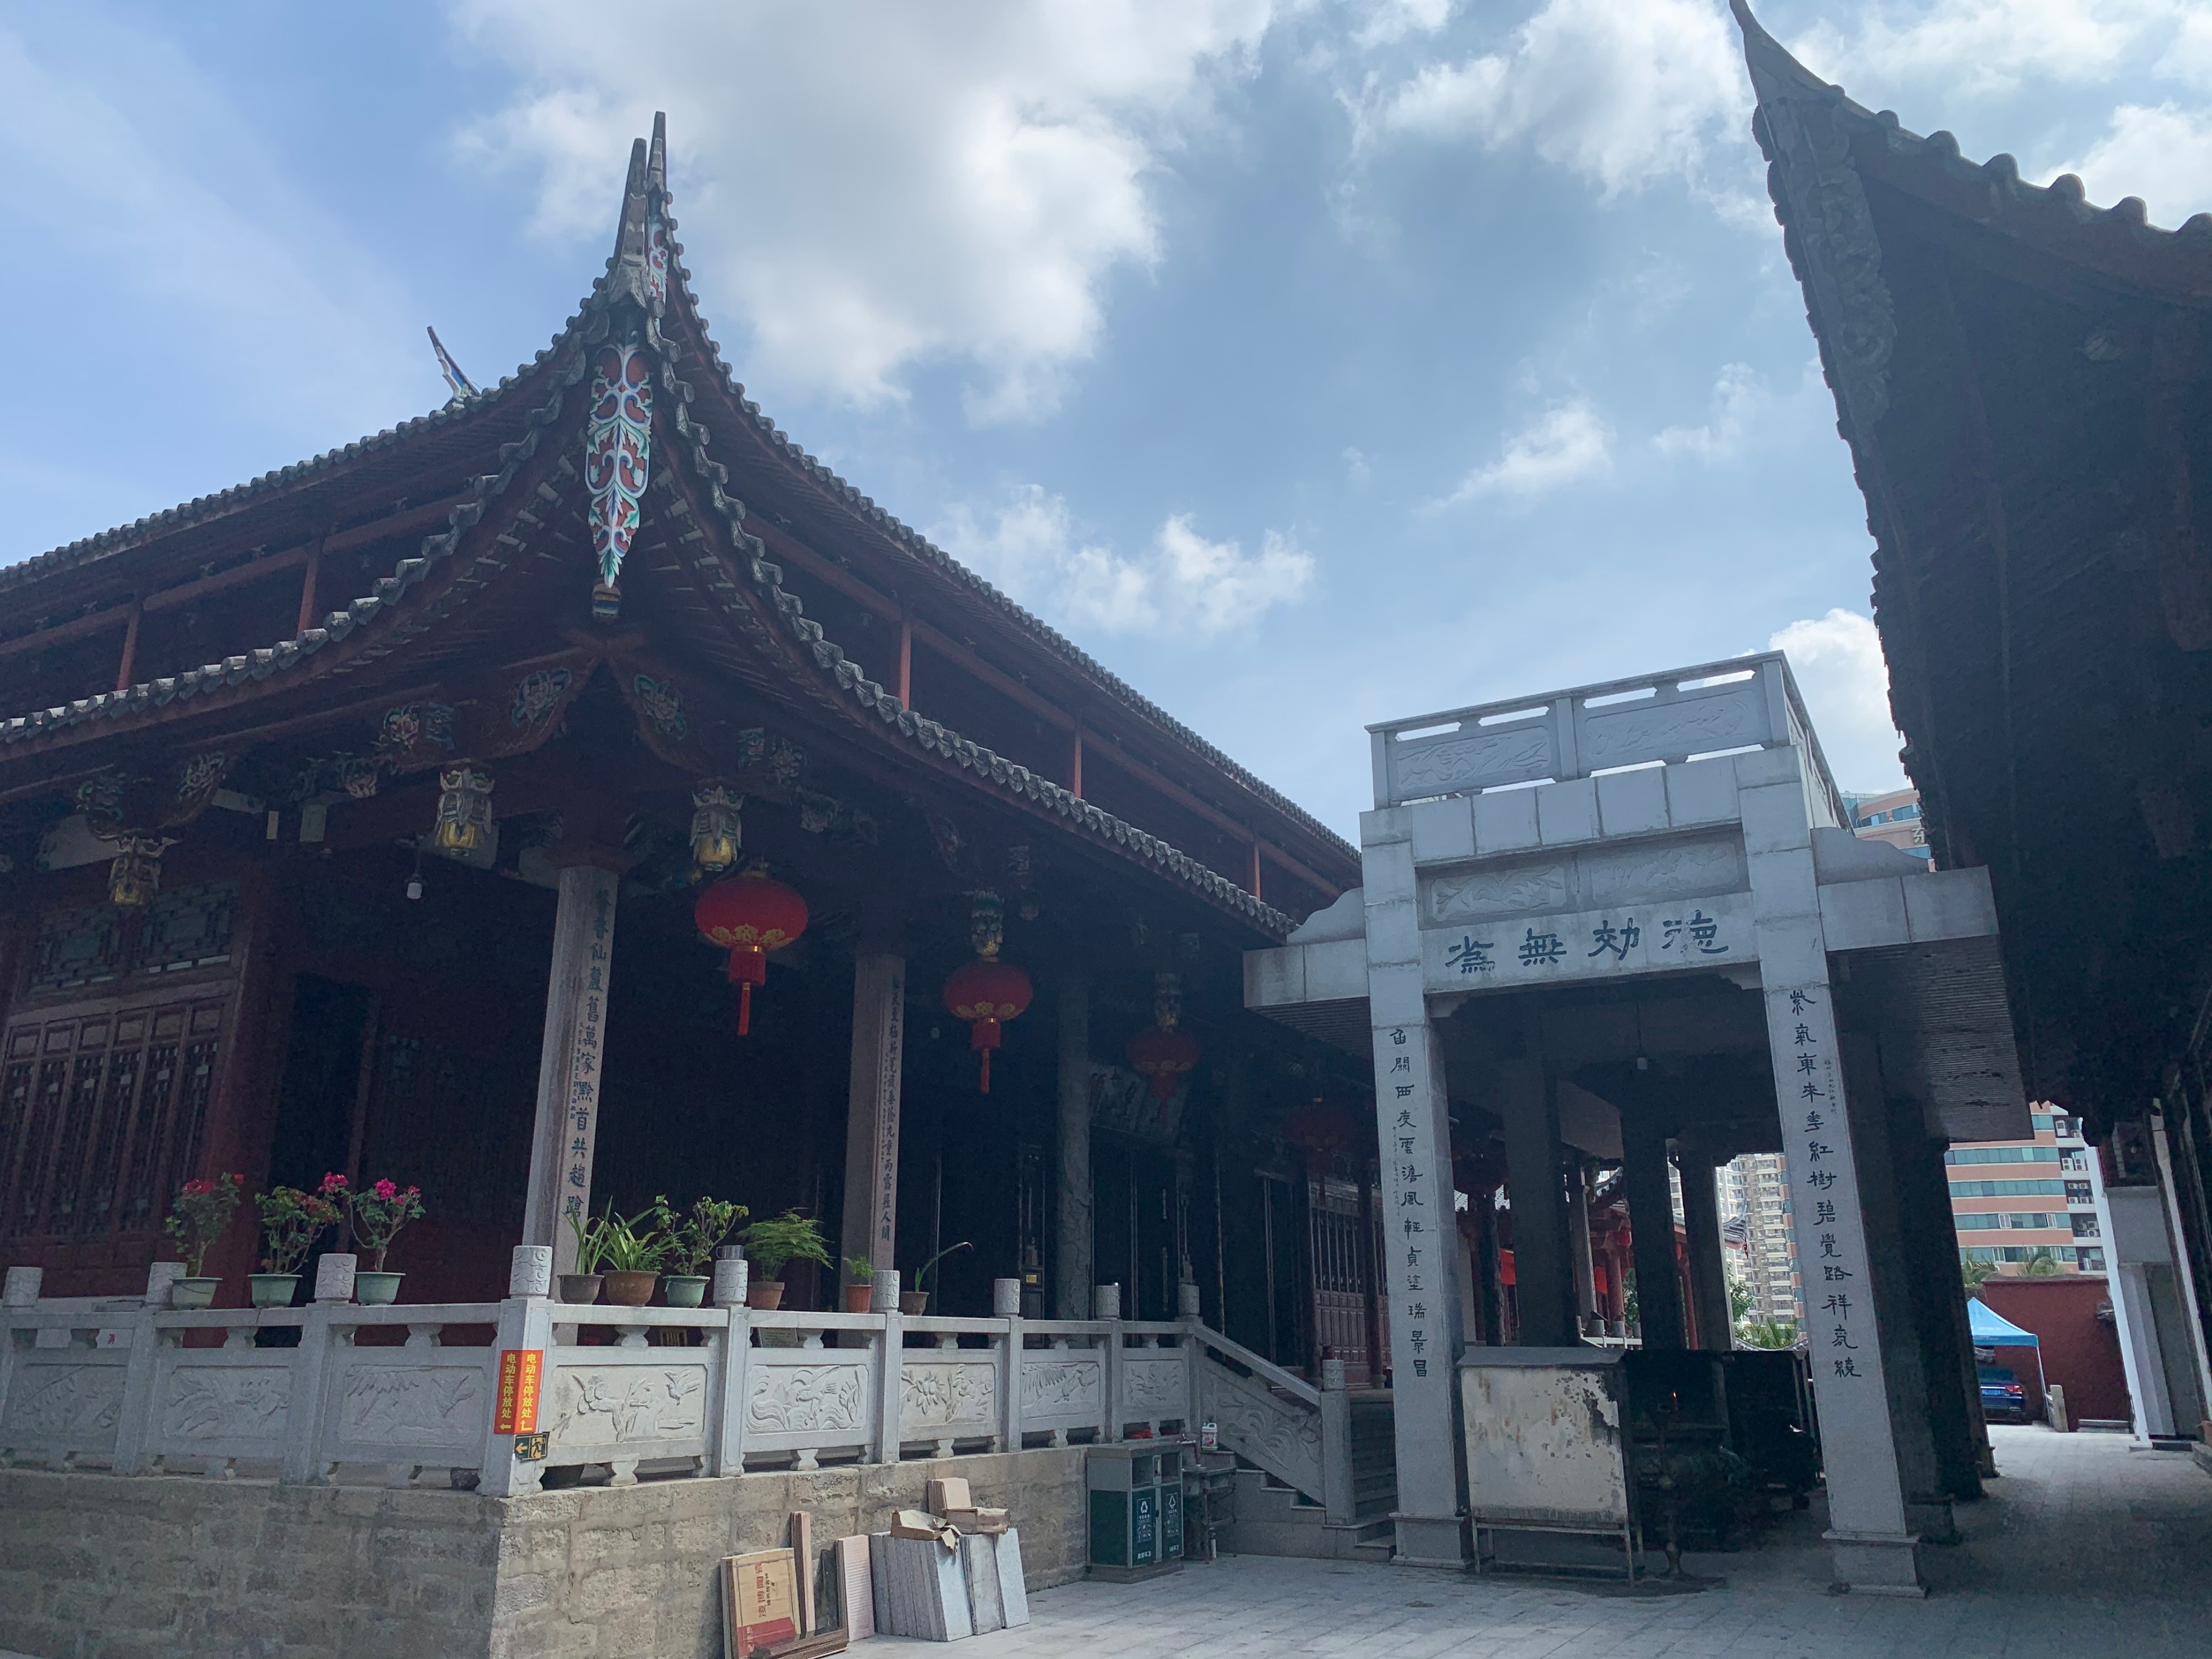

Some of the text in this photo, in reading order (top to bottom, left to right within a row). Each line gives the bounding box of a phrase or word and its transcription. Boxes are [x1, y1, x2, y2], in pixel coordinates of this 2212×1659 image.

[501, 1353, 516, 1418] 电动车停放处
[521, 1353, 537, 1418] 电动车停放处
